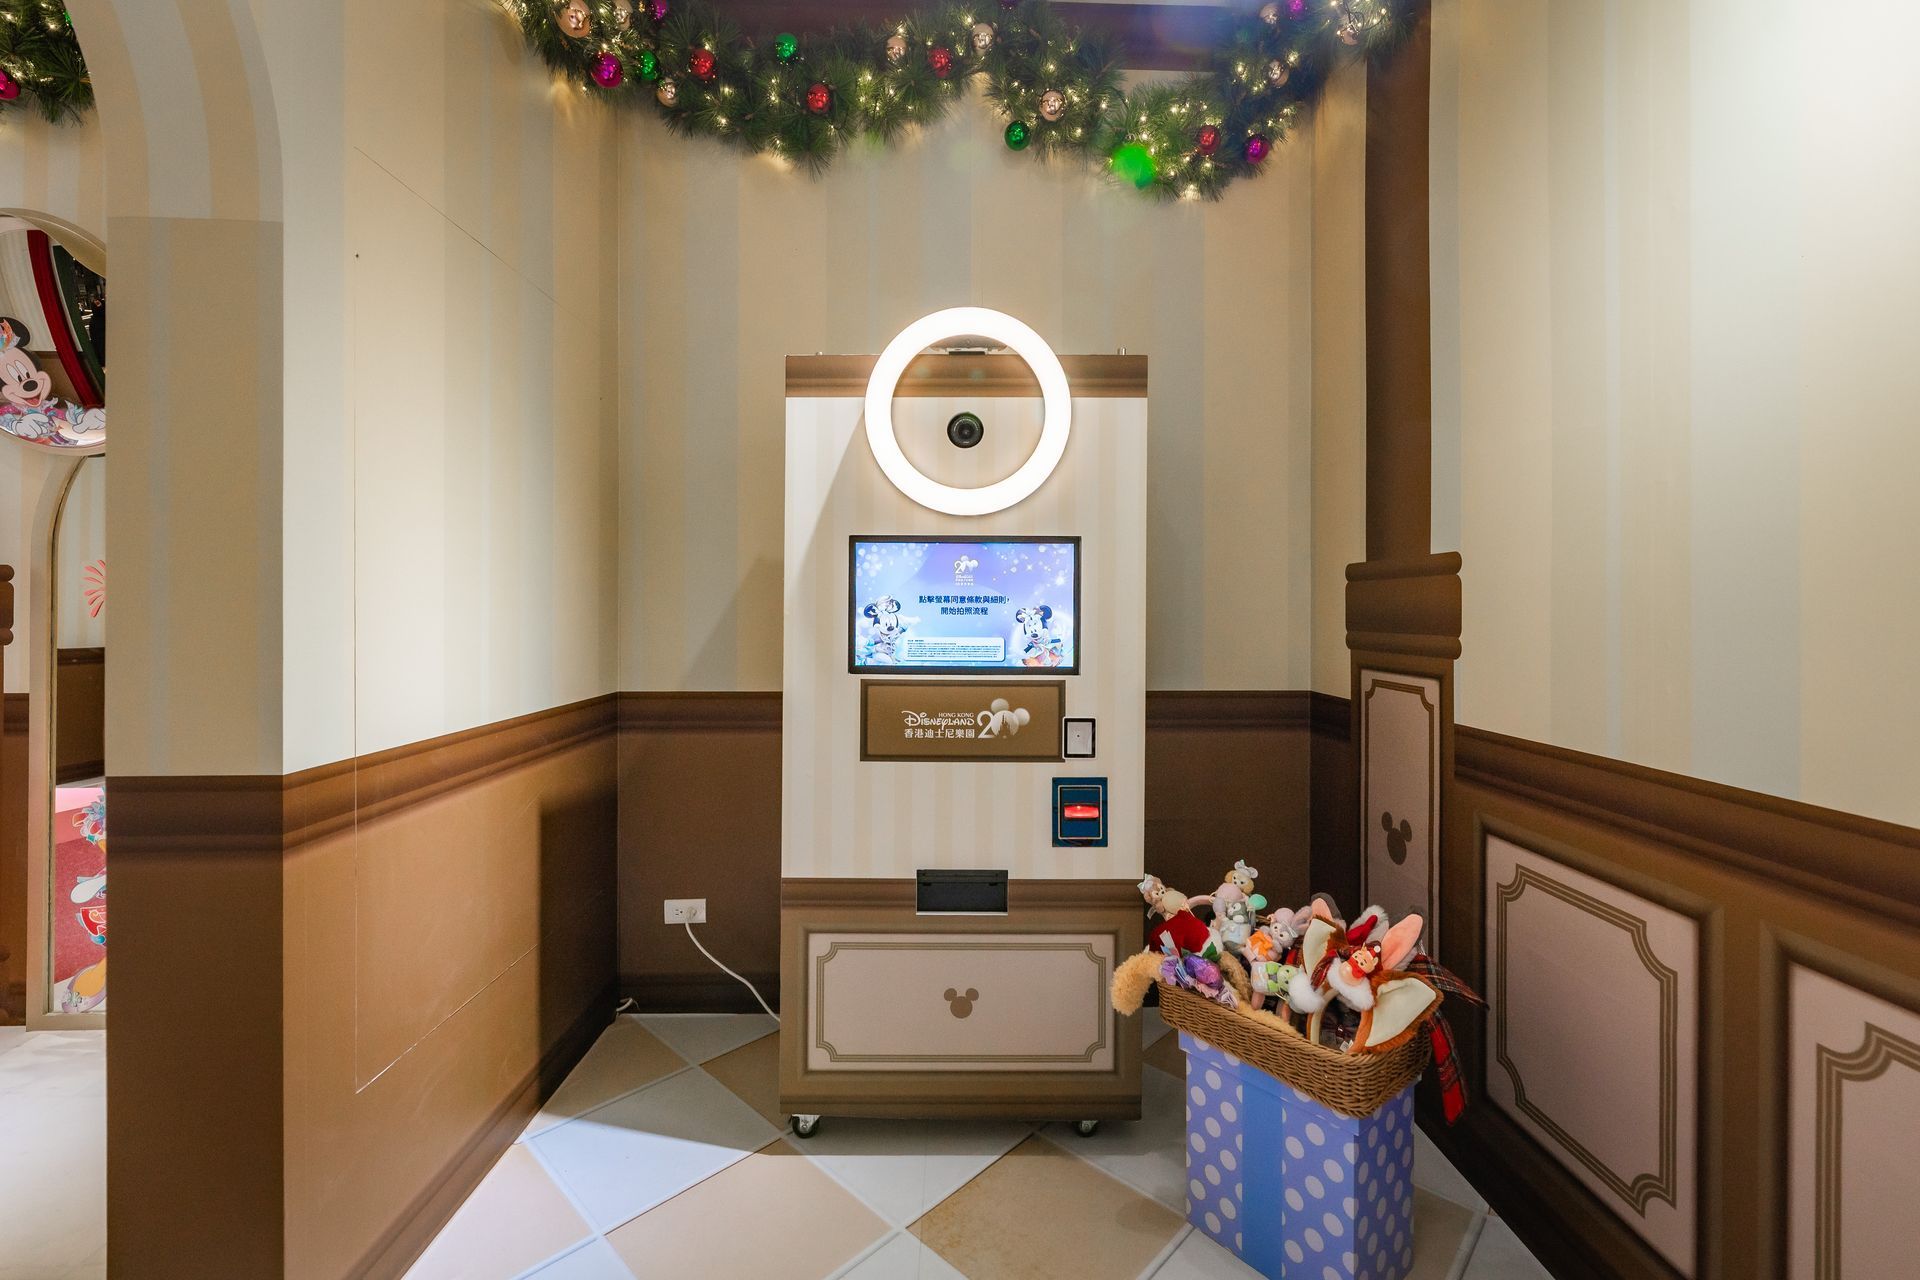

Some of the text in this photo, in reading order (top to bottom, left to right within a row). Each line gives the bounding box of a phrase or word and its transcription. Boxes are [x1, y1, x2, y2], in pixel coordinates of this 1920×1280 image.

[940, 606, 989, 615] 開始拍照流程
[904, 728, 975, 739] 香港迪士尼樂園
